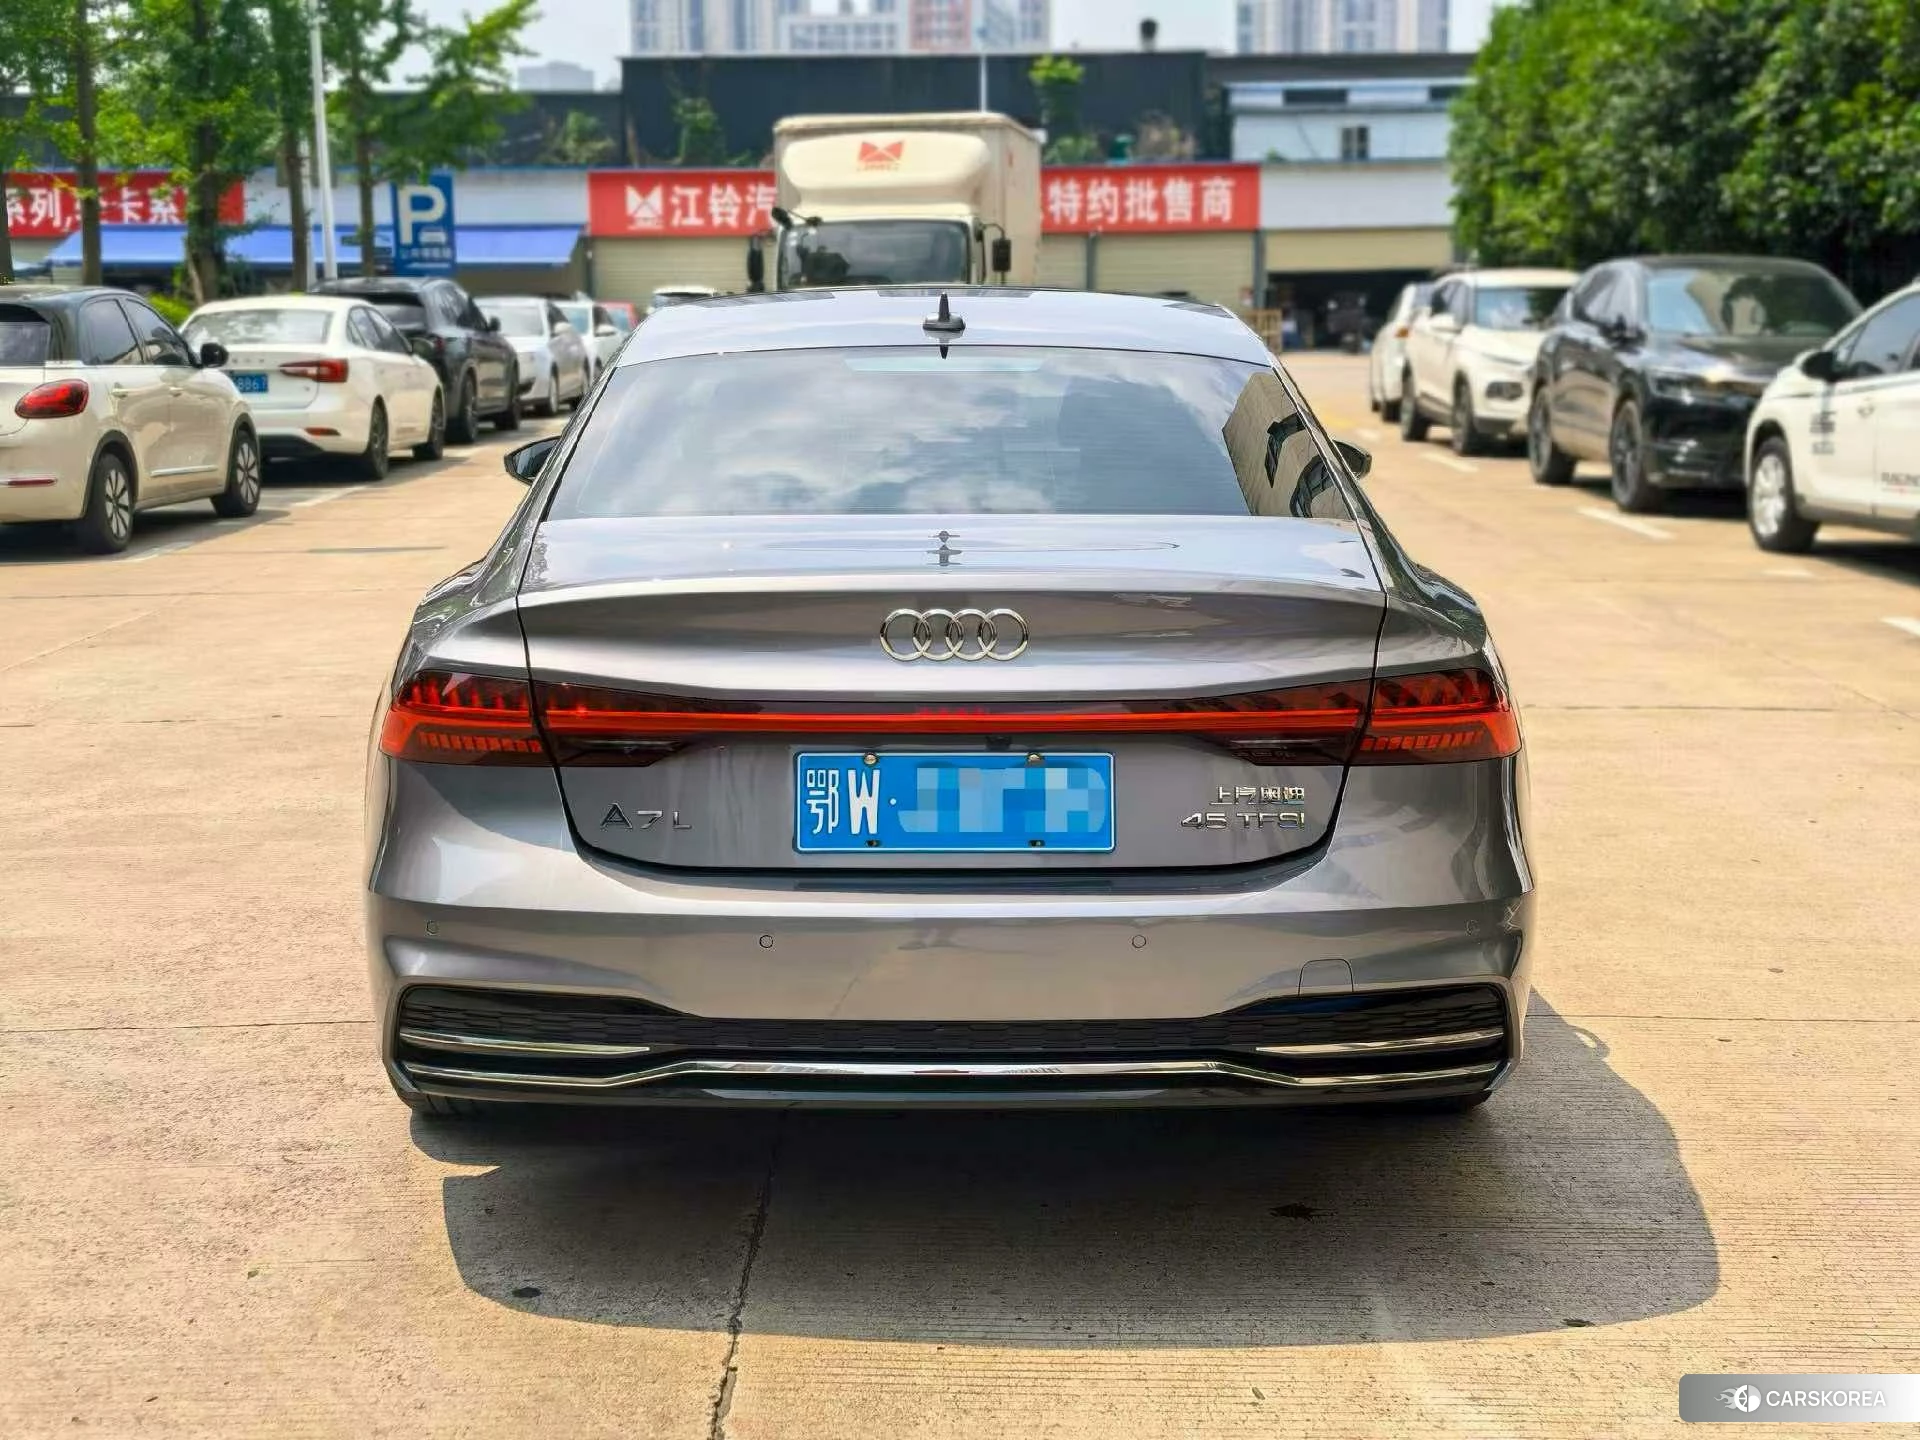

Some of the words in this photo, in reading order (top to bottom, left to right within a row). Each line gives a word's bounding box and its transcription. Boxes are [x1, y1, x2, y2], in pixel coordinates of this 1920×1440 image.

[398, 185, 446, 245] P
[1048, 176, 1236, 224] 特约批售商
[1181, 812, 1227, 830] 45
[1236, 812, 1305, 830] TFSI
